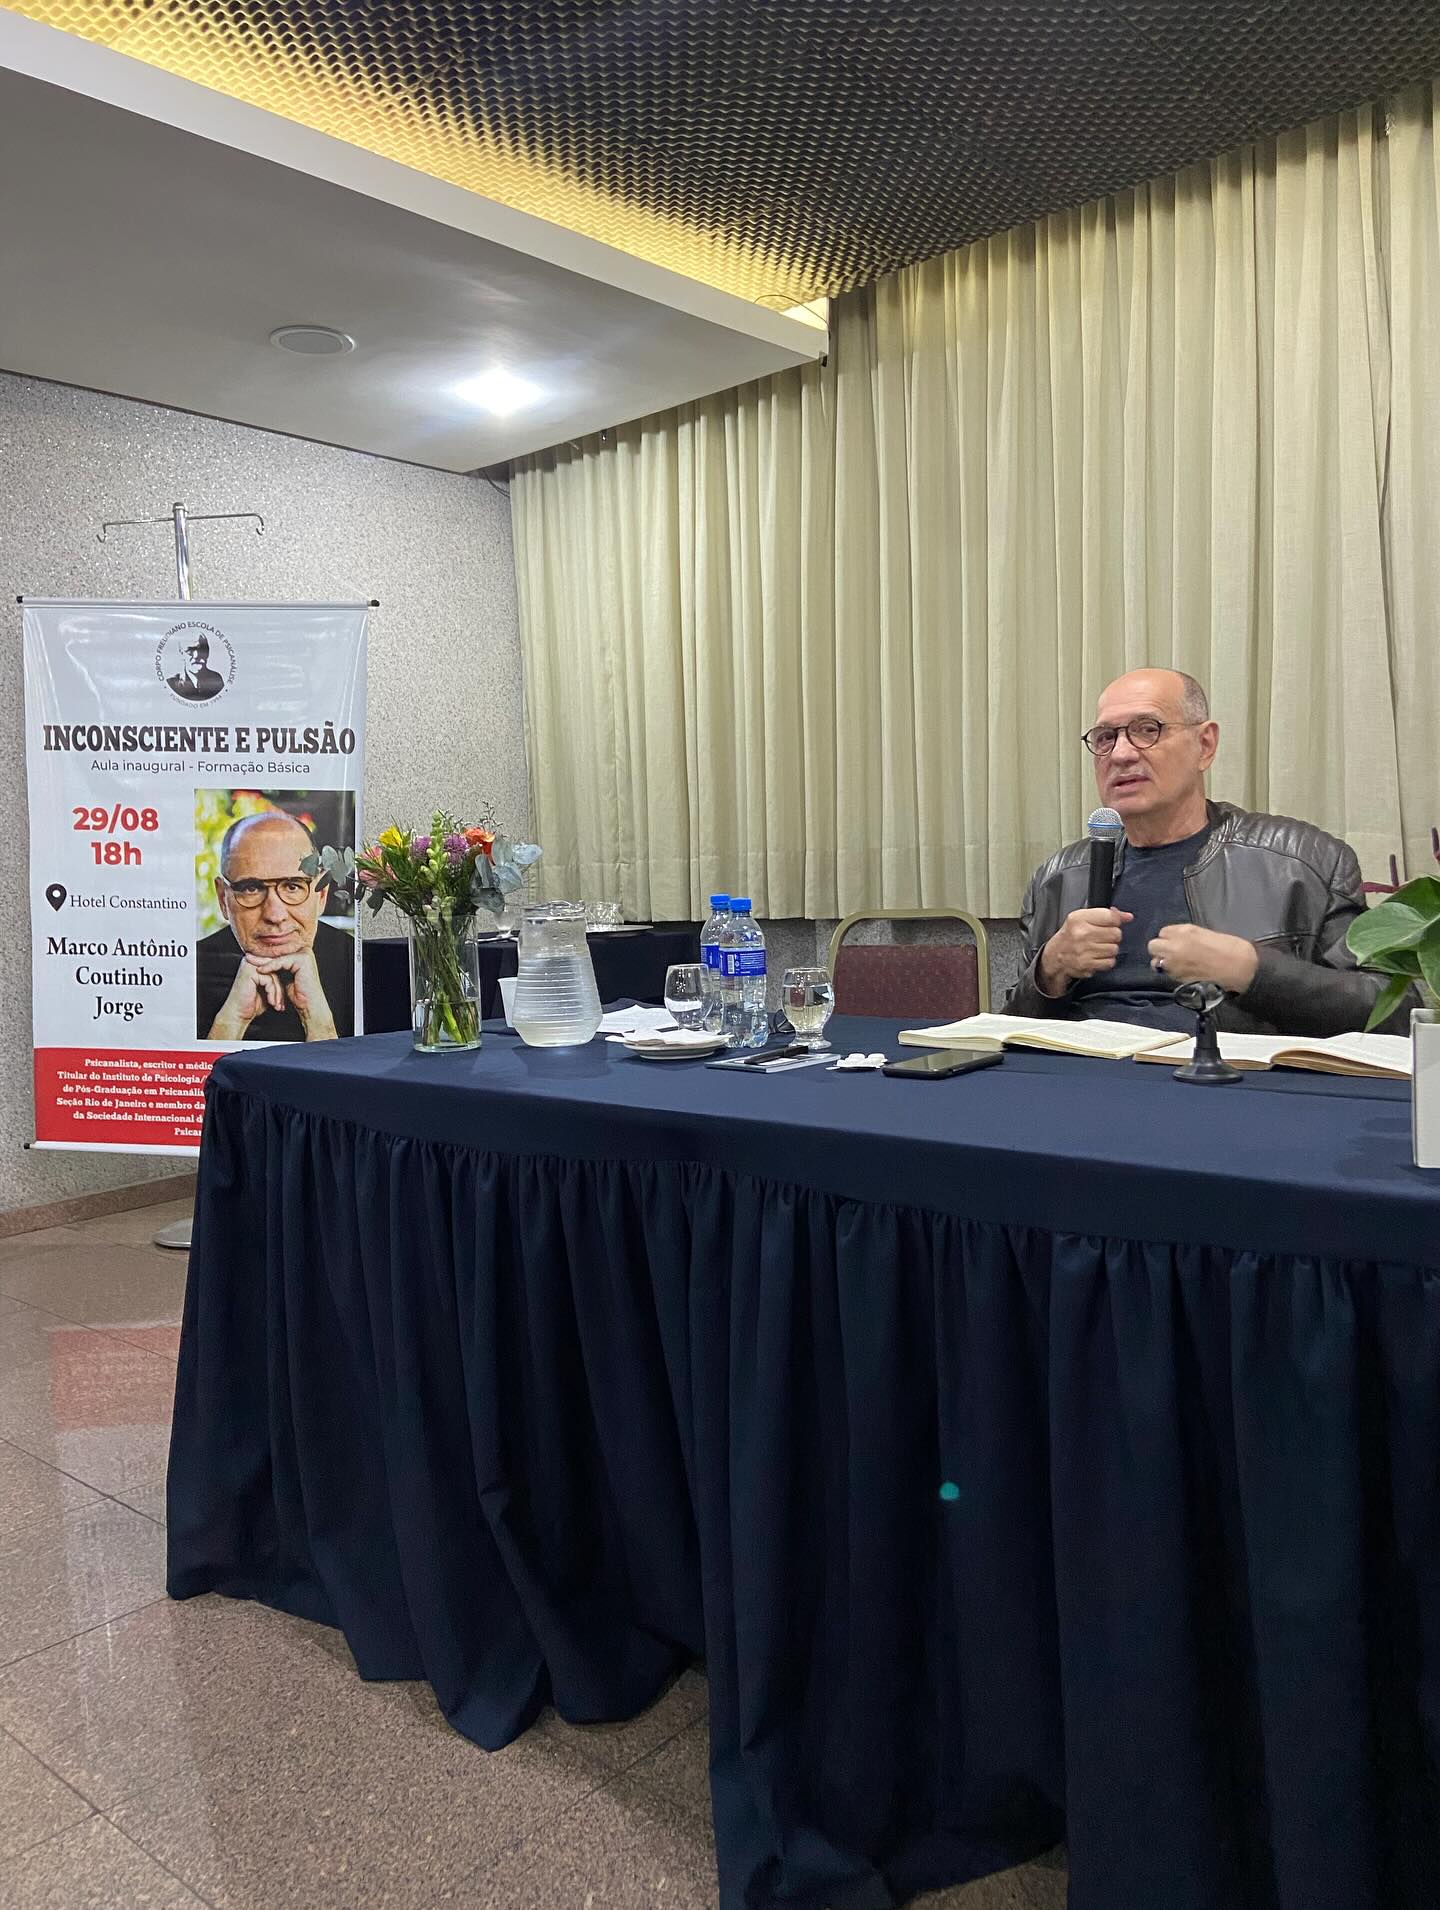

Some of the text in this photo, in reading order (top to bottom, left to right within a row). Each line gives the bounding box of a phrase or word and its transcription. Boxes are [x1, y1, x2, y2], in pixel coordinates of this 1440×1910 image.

[155, 655, 164, 681] CORPO
[187, 621, 215, 633] ESCOLA
[215, 630, 225, 640] DE
[43, 721, 356, 755] INCONSCIENTE E PULSÃO
[91, 759, 119, 772] Aula
[123, 760, 185, 775] inaugural
[198, 760, 263, 775] Formação
[268, 760, 310, 774] Básica
[72, 803, 159, 834] 29/08
[90, 841, 142, 866] 18h
[70, 894, 188, 910] Hotel Constantino
[46, 937, 188, 959] Marco Antônio
[75, 966, 163, 987] Coutinho
[94, 996, 144, 1022] Jorge
[84, 1059, 142, 1069] Psicanalista,
[143, 1061, 176, 1069] escritor
[185, 1060, 214, 1070] médic
[57, 1071, 208, 1085] Titular do Instituto de Psicologia/
[63, 1084, 74, 1093] de
[75, 1084, 143, 1096] Pós-Graduação
[159, 1087, 205, 1097] Psicanális
[56, 1097, 83, 1107] Seção
[85, 1098, 100, 1106] Rio
[102, 1098, 113, 1107] de
[114, 1099, 147, 1109] Janeiro
[155, 1101, 193, 1109] membro
[73, 1111, 203, 1123] da Sociedade Internacional d
